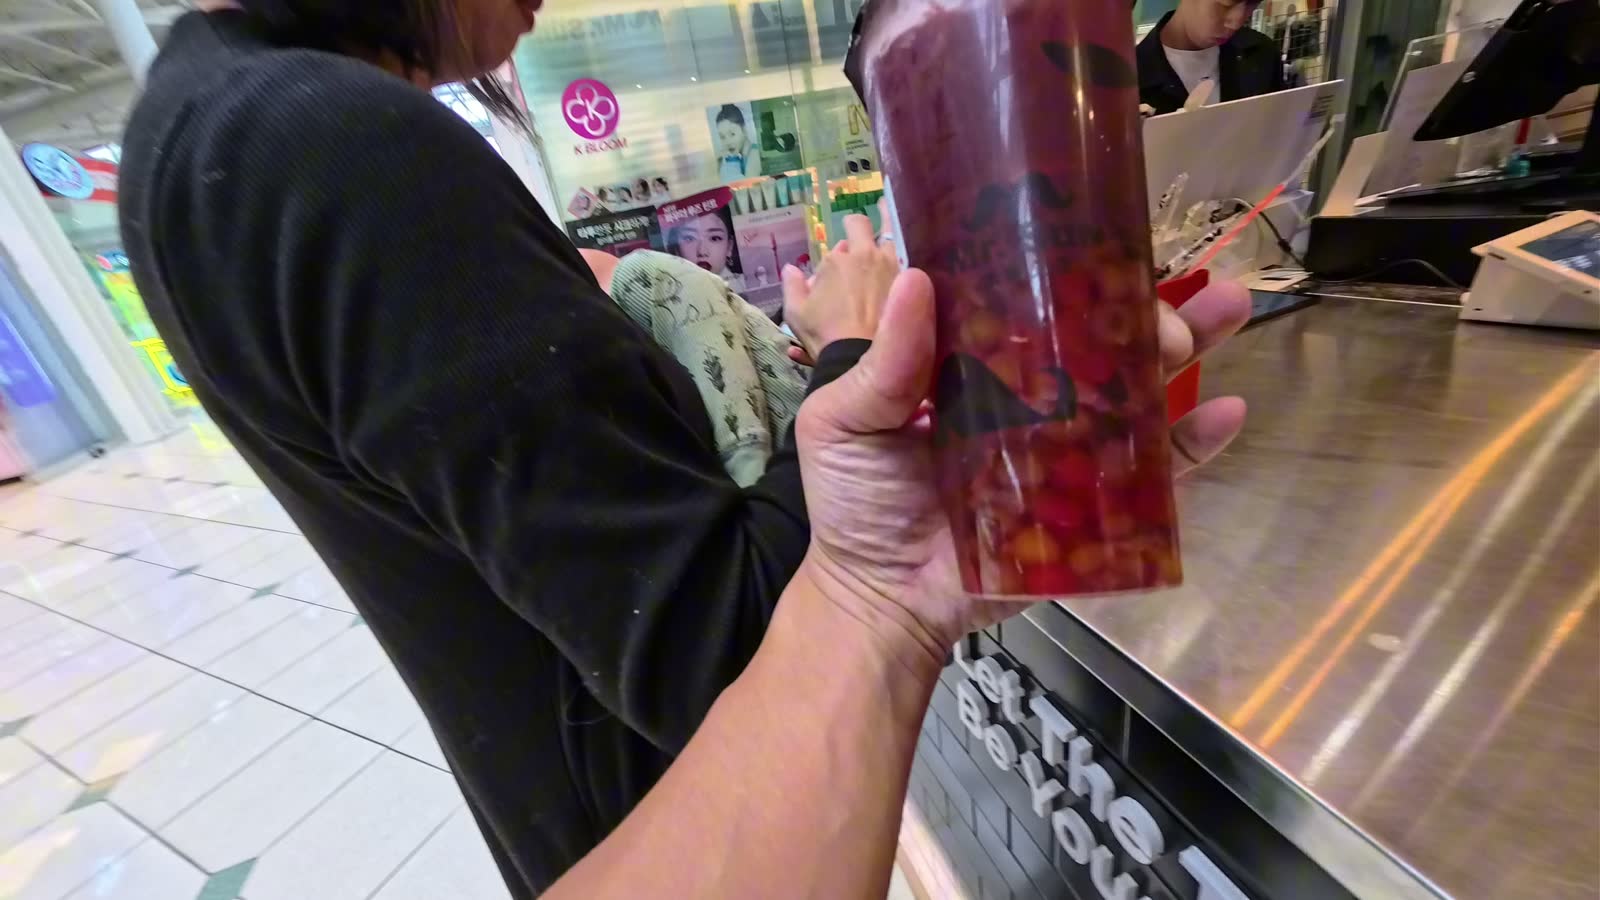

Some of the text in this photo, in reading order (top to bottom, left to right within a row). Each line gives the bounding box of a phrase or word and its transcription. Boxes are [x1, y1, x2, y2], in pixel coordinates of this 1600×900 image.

[574, 137, 628, 155] K BLOOM
[953, 641, 1025, 725] Let
[1030, 695, 1164, 865] The
[957, 678, 1145, 900] Be You
